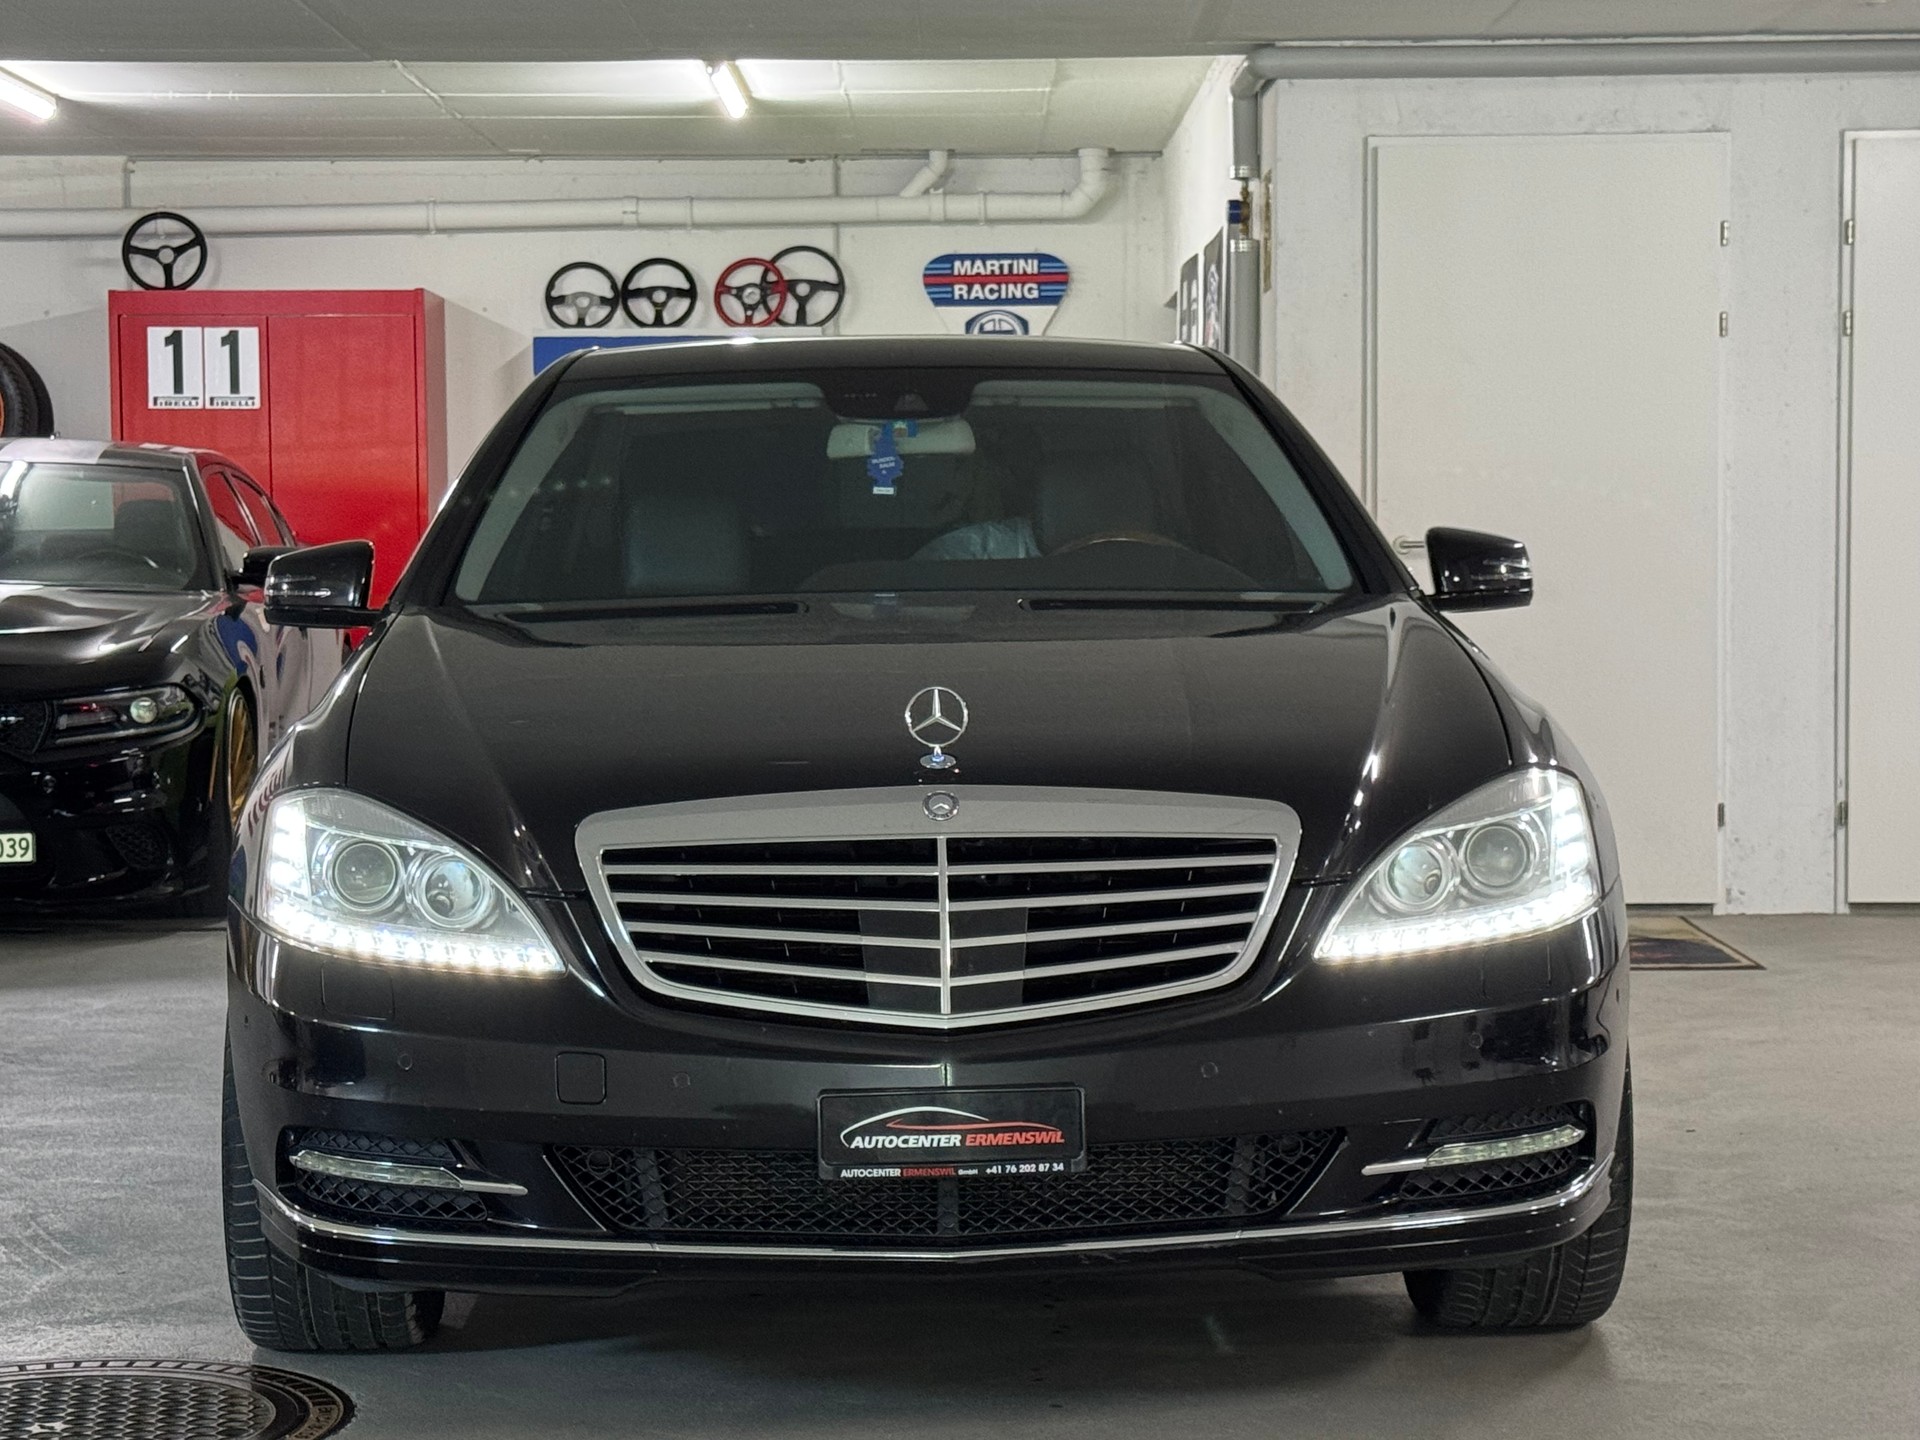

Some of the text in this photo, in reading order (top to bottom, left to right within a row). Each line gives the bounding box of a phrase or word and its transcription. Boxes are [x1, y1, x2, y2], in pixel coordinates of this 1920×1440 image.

[953, 259, 1039, 276] MARTINI
[953, 283, 1039, 300] RACING
[153, 396, 199, 407] PIRELLI
[209, 396, 256, 407] PIRELLI
[849, 1131, 1065, 1149] AUTOCENTER ERMENSWIL
[840, 1167, 901, 1178] AUTOCENTER
[902, 1167, 956, 1177] ERMENSWIL
[985, 1165, 1002, 1175] +41
[1005, 1164, 1018, 1174] 76
[1019, 1163, 1037, 1173] 202
[1038, 1163, 1050, 1172] 87
[1052, 1162, 1065, 1172] 34
